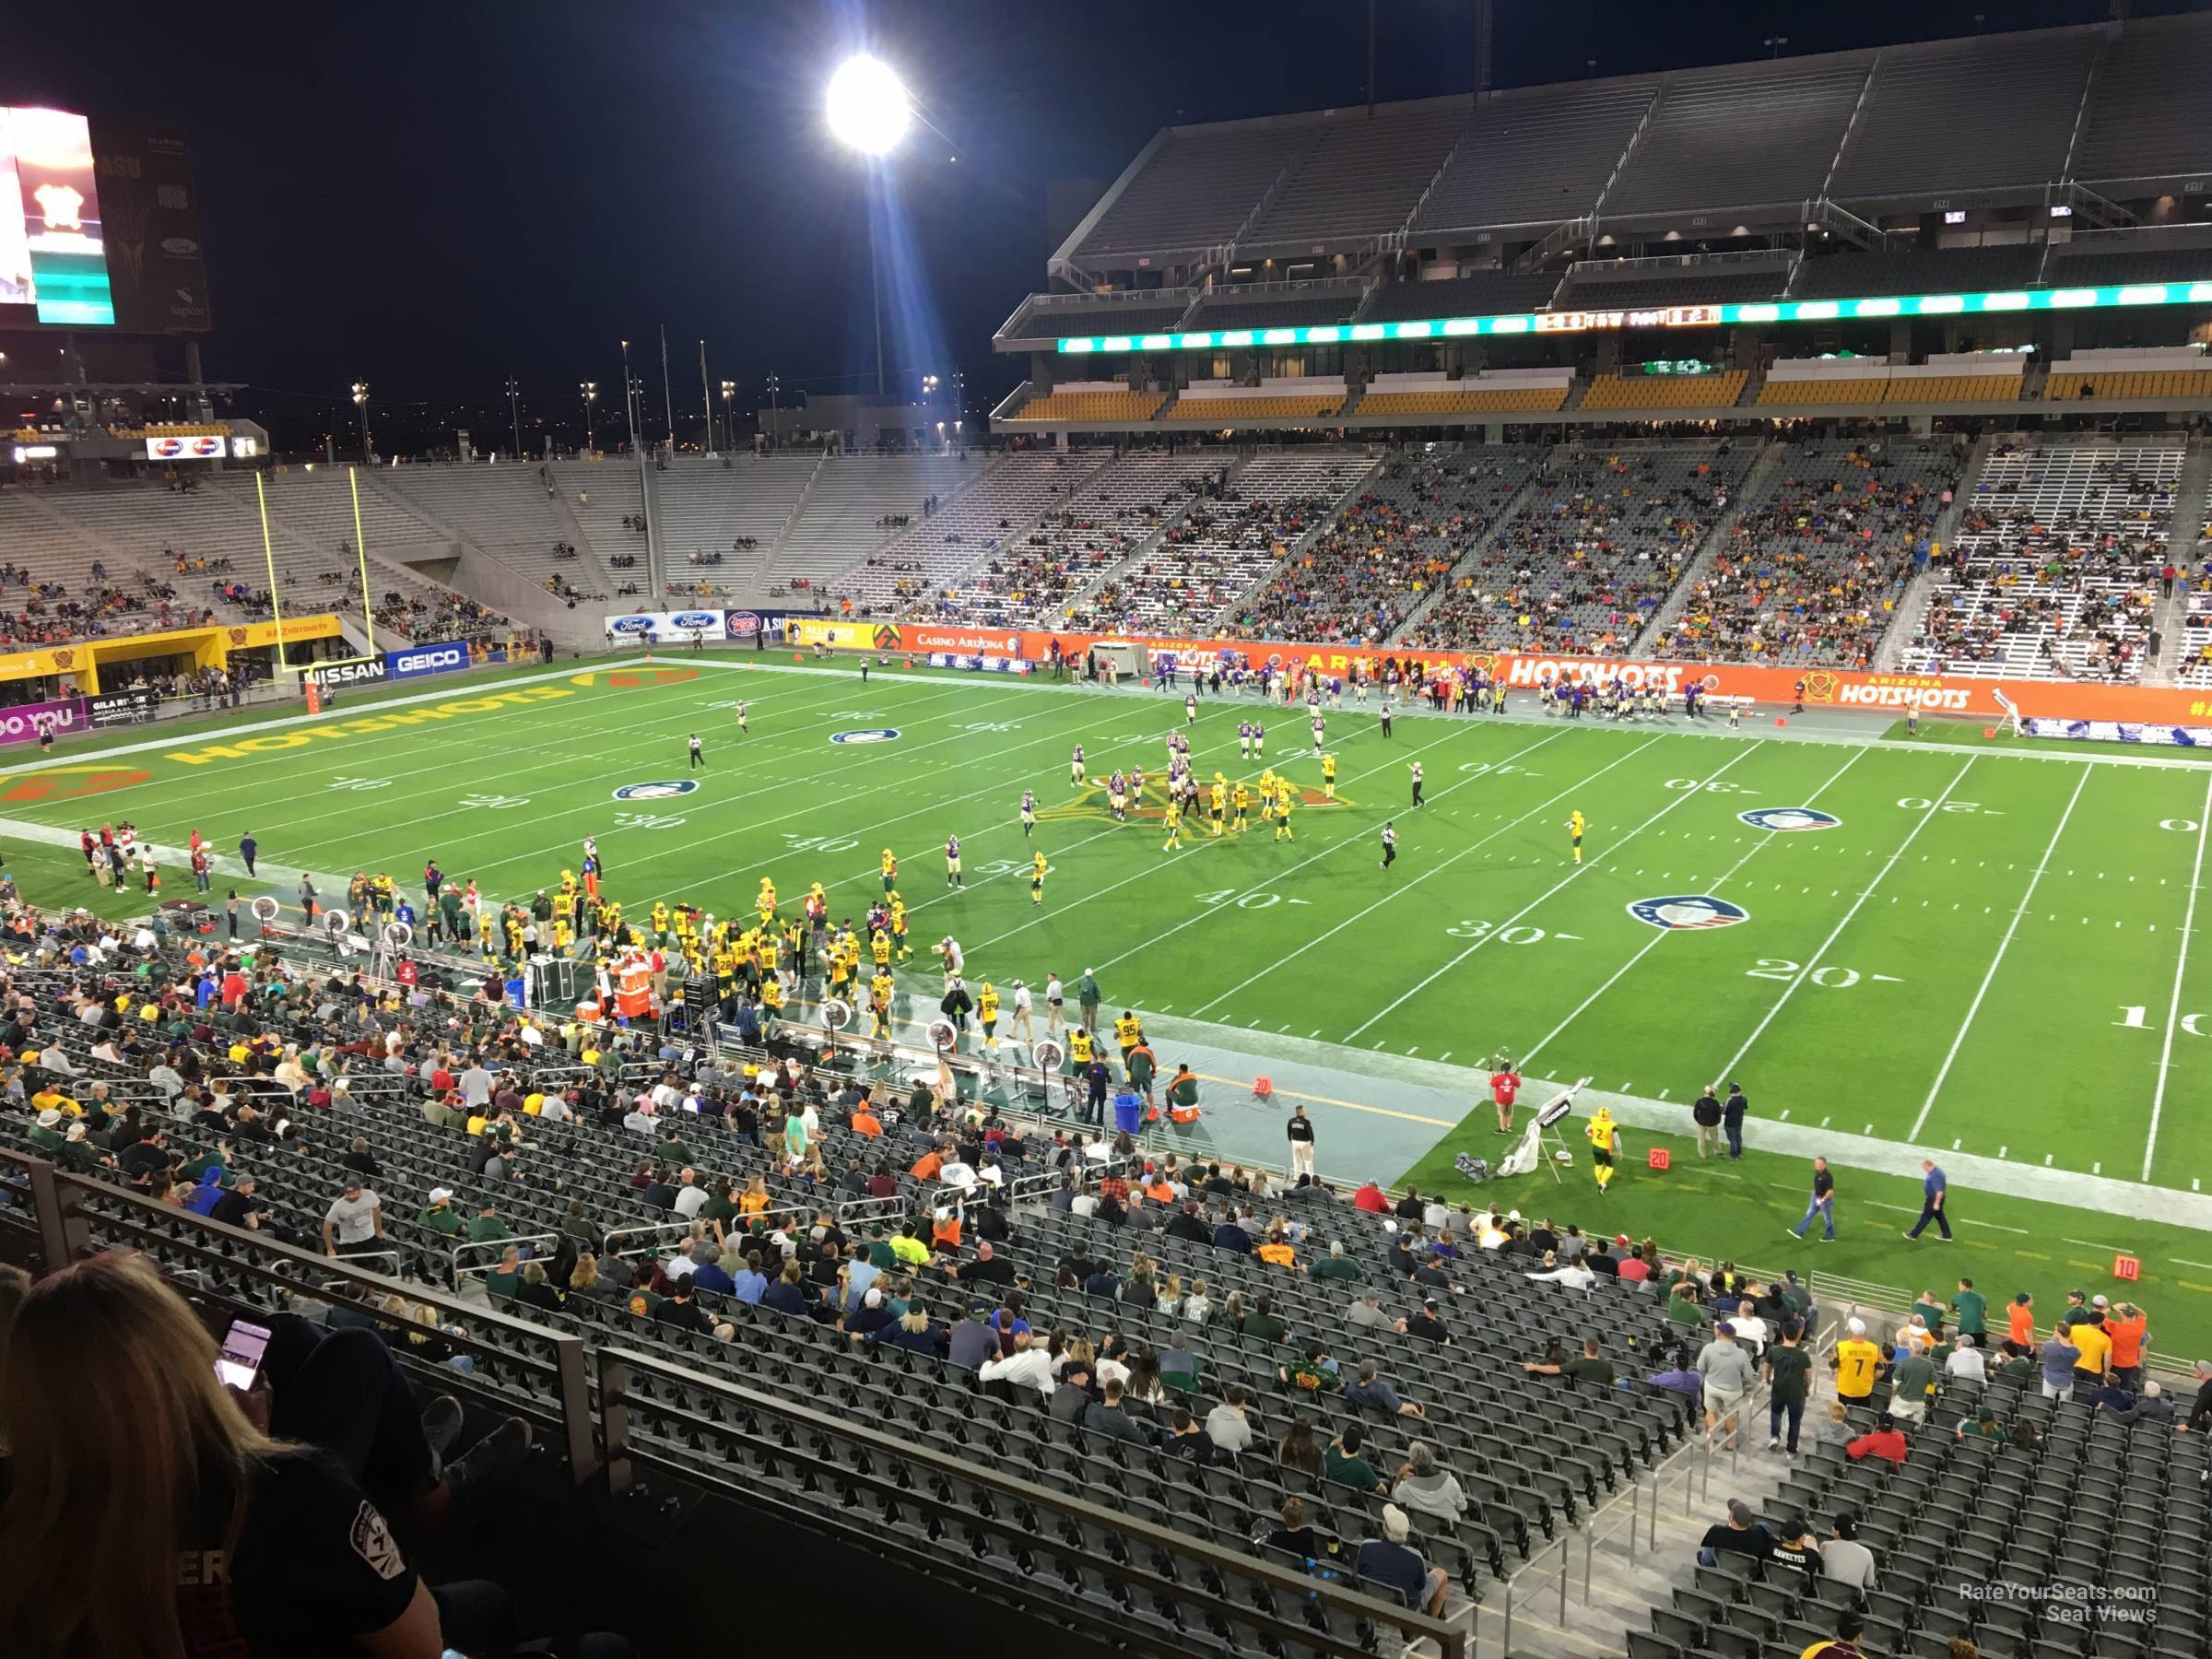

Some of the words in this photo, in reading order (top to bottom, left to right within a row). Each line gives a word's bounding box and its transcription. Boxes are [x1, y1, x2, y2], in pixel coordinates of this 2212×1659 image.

[620, 618, 647, 630] Ford
[680, 615, 708, 627] Ford
[1150, 641, 1199, 650] ARIZONA
[397, 649, 460, 672] GEICO
[303, 661, 384, 686] NISSAN
[1509, 658, 1684, 692] HOTSHOTS
[1868, 677, 1943, 688] ARIZONA
[93, 699, 116, 710] GILA
[1840, 684, 1972, 709] HOTSHOTS
[27, 708, 73, 733] YOU
[164, 686, 577, 765] HOTSHOTS
[1896, 797, 1982, 814] 20
[974, 859, 1056, 878] 50
[1194, 888, 1281, 910] 40
[1445, 920, 1546, 945] 30
[876, 947, 888, 959] 55
[1746, 959, 1861, 988] 20
[985, 1001, 998, 1012] 94
[2111, 1005, 2212, 1037] 10
[1123, 1024, 1136, 1037] 95
[1074, 1042, 1087, 1055] 92
[1254, 1077, 1268, 1092] 30
[1596, 1128, 1605, 1141] 2
[1651, 1151, 1666, 1167] 20
[2119, 1260, 2136, 1277] 10
[1855, 1359, 1865, 1377] 7
[1773, 1548, 1806, 1564] HAWKEYES
